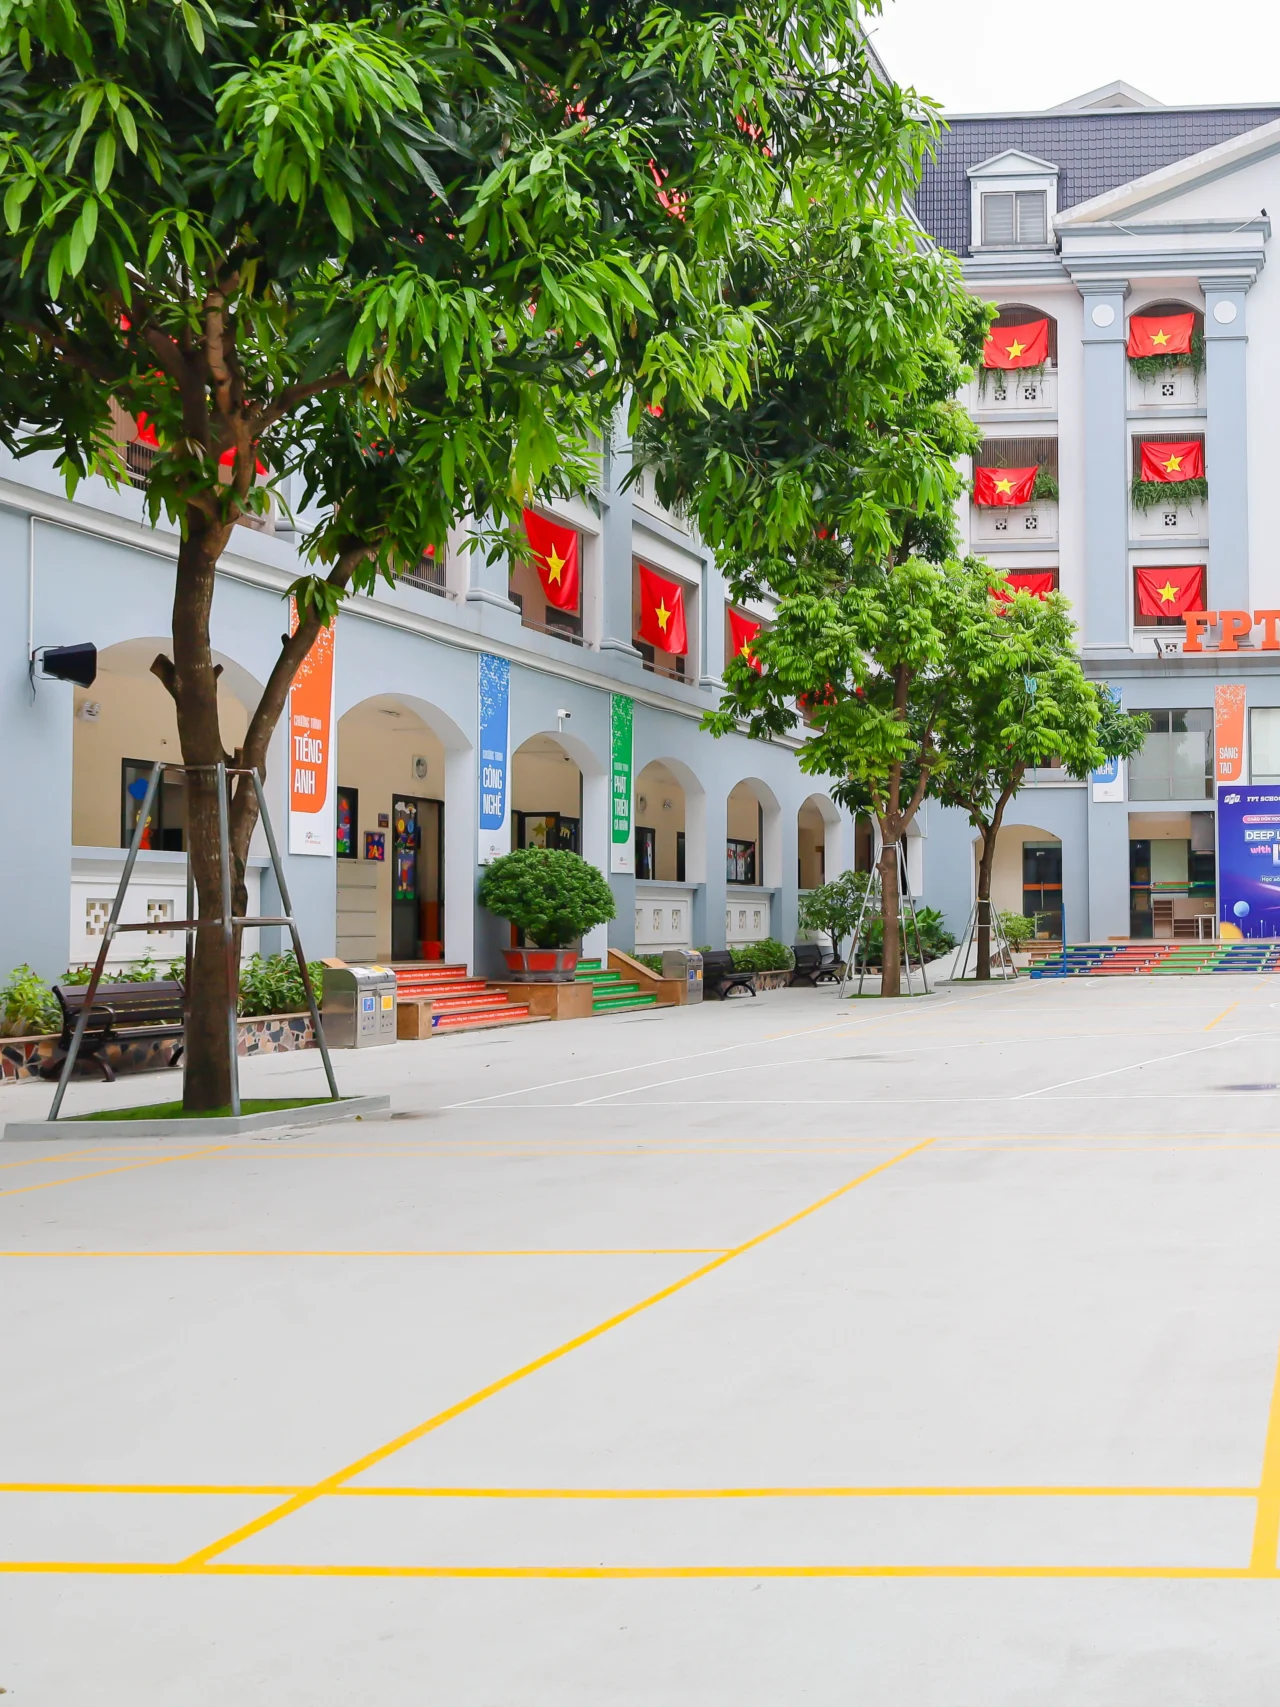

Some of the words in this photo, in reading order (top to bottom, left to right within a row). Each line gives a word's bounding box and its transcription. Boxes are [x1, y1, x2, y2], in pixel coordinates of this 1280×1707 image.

[294, 731, 322, 764] TIẾNG
[1220, 745, 1238, 759] SÁNG
[483, 764, 502, 789] CÔNG
[1220, 762, 1231, 775] TẠO
[294, 768, 315, 794] ANH
[614, 773, 626, 794] PHÁT
[483, 792, 502, 817] NGHỆ
[614, 794, 628, 816] TRIỂN
[1246, 831, 1274, 840] DEEP
[1250, 845, 1271, 853] with
